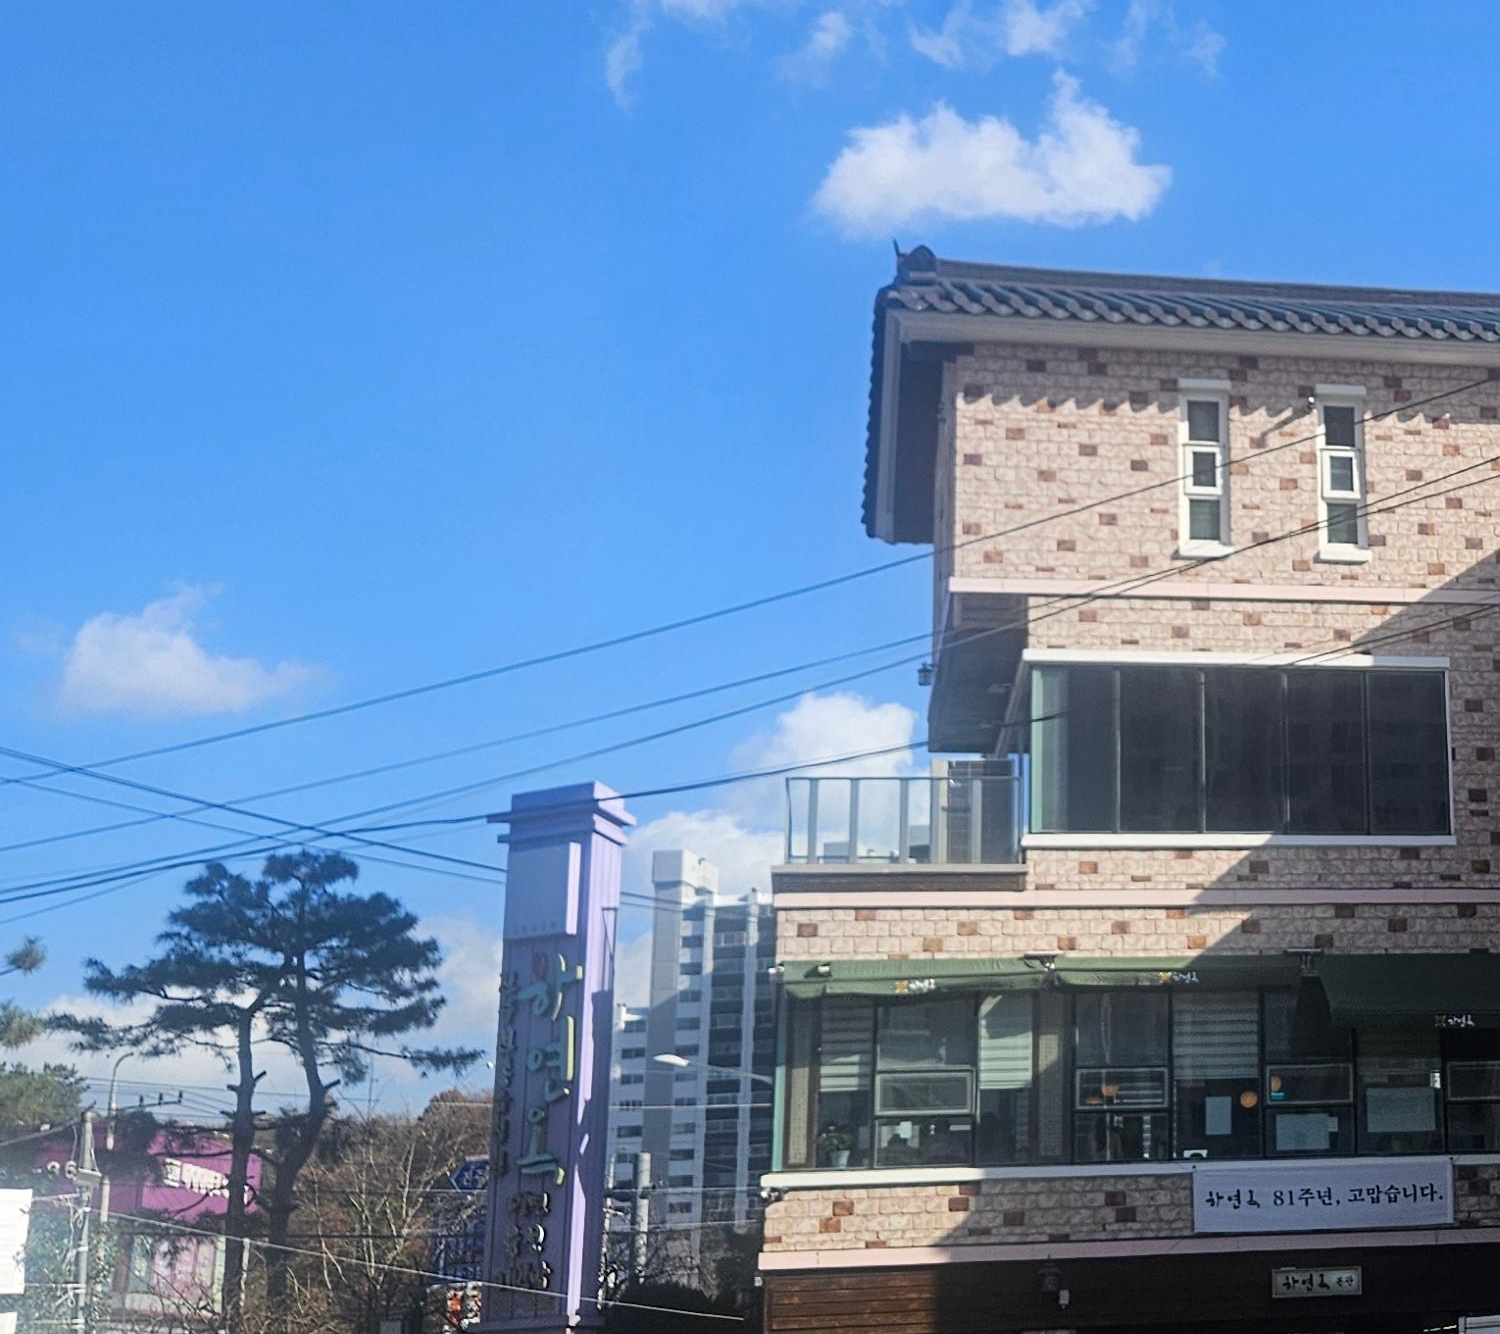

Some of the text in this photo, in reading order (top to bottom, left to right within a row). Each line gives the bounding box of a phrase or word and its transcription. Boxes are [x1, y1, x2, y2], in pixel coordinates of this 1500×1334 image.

[1205, 1182, 1444, 1210] 하연옥 81주년, 고맙습니다.
[1282, 1273, 1331, 1292] 하연옥
